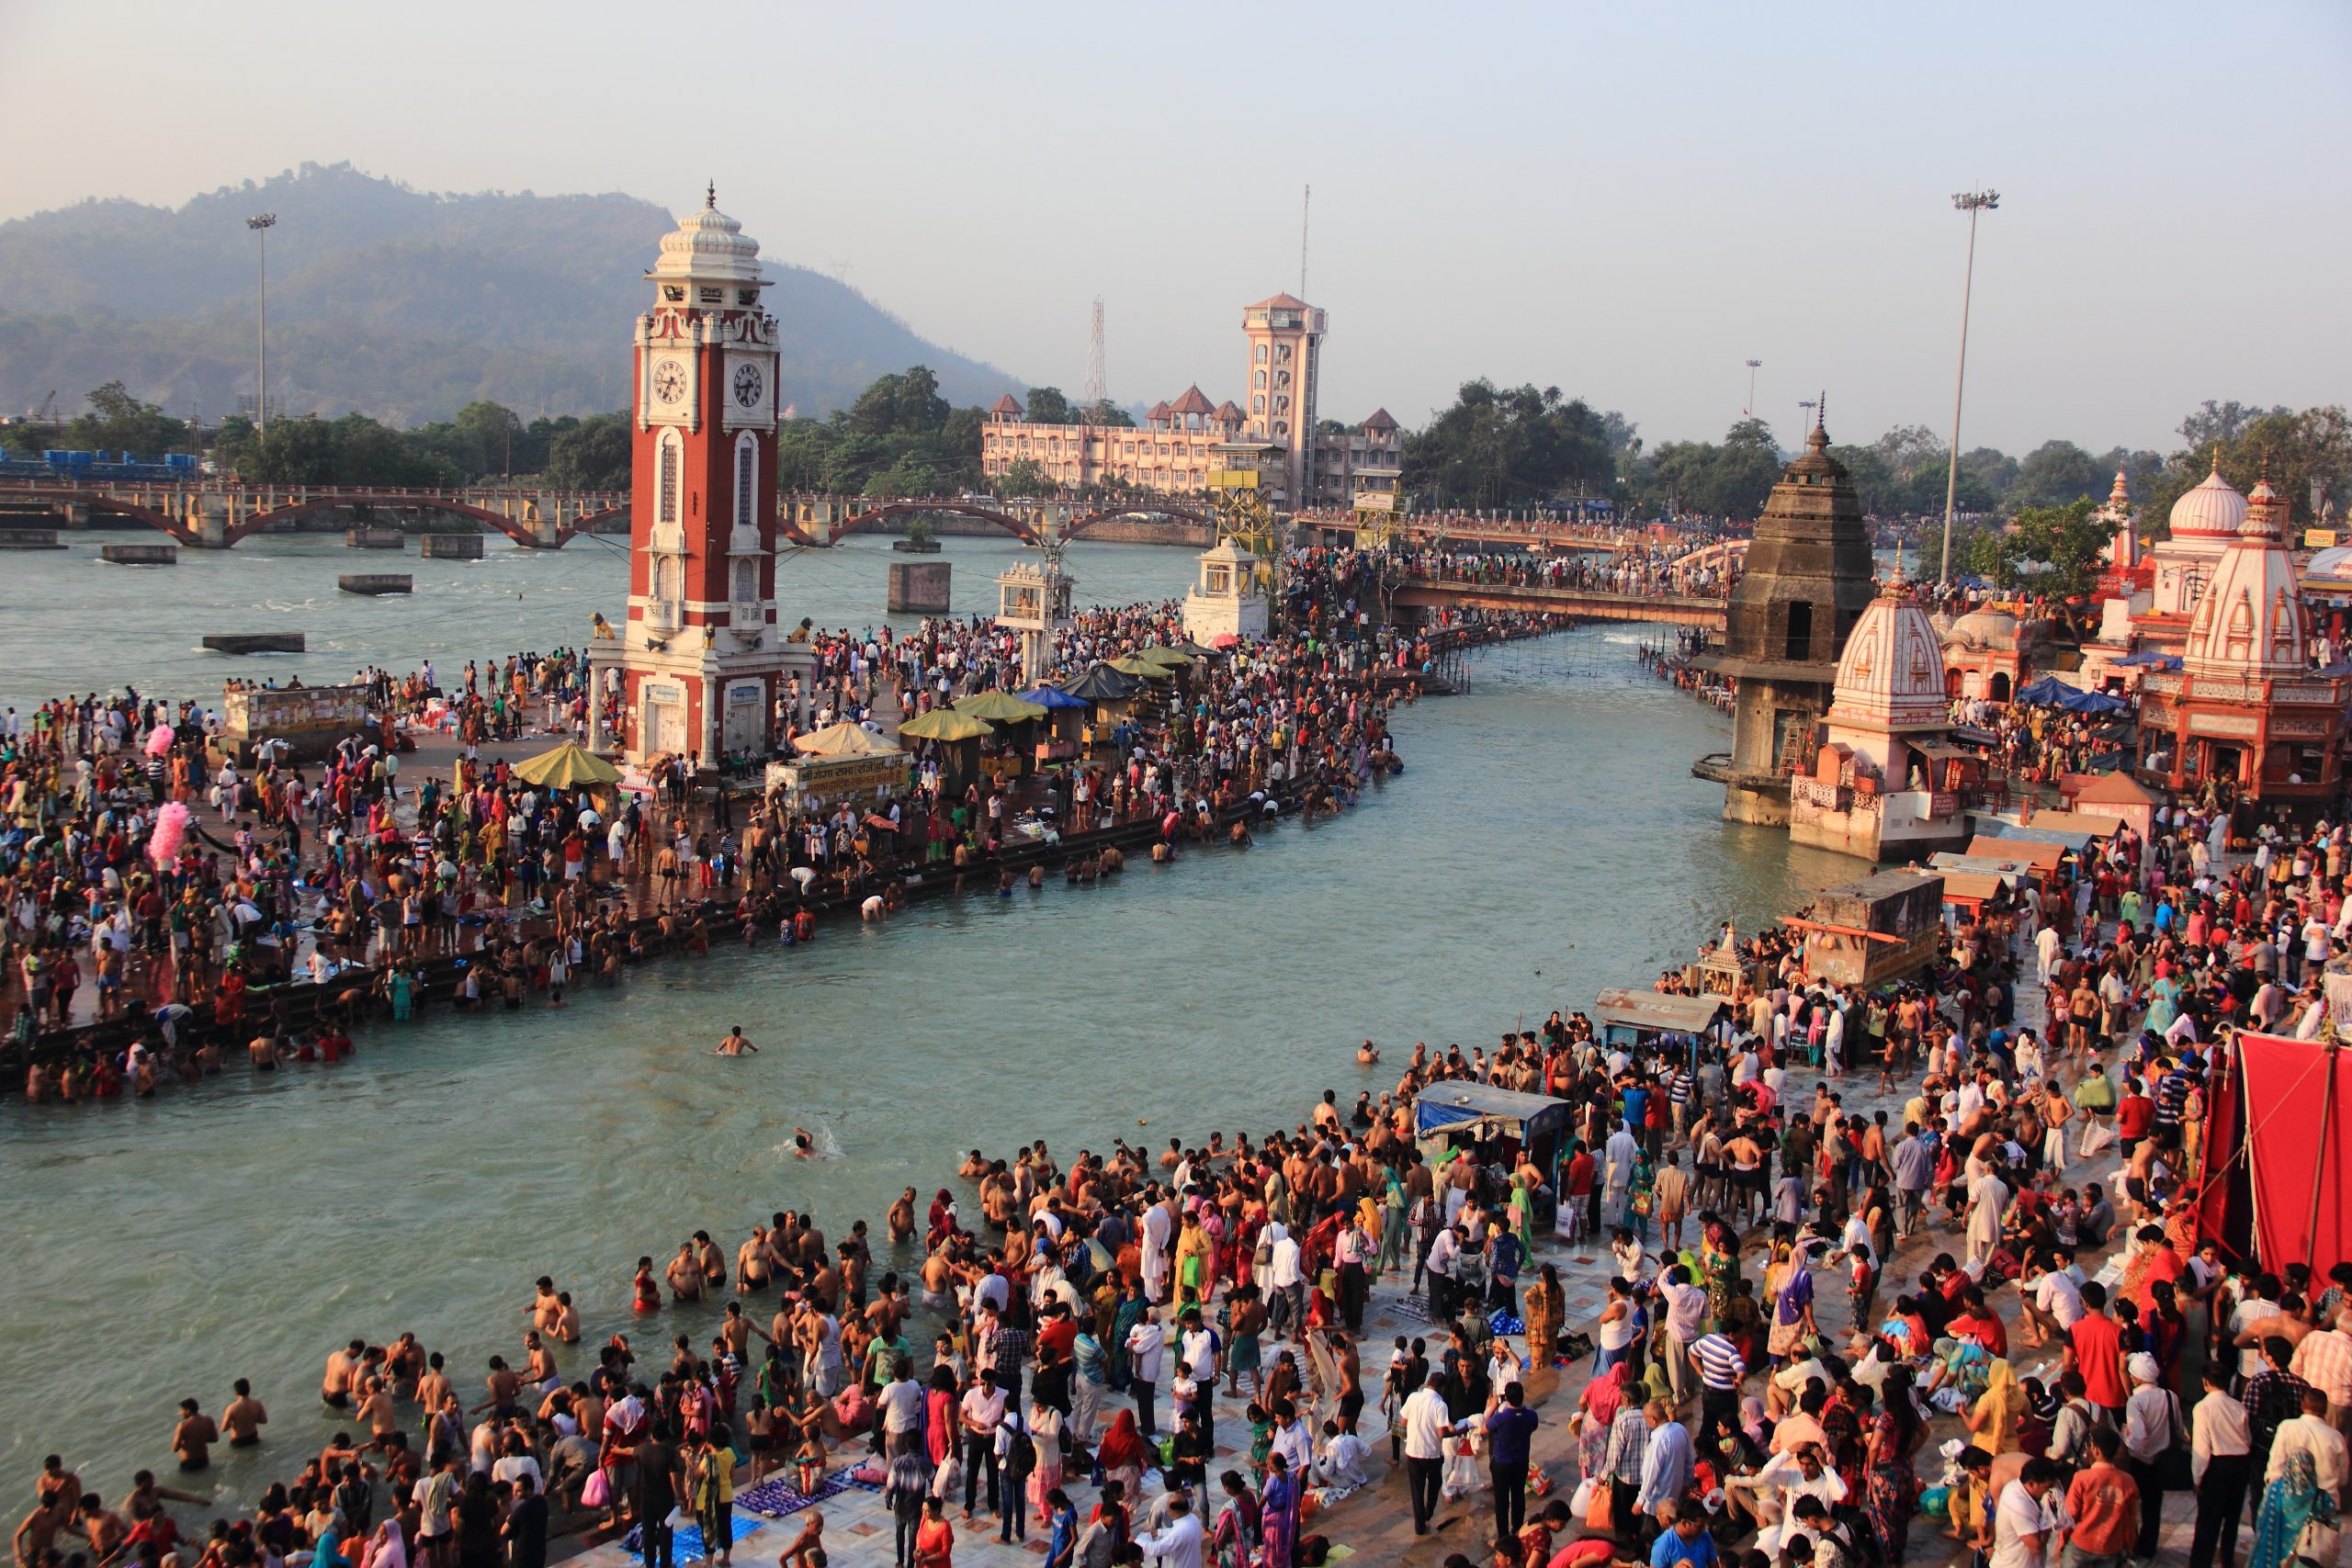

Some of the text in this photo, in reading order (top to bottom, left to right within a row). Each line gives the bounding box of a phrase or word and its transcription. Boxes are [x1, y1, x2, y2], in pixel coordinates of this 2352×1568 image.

[802, 770, 812, 782] श्री
[813, 768, 832, 779] गंगा
[836, 766, 854, 776] सभा
